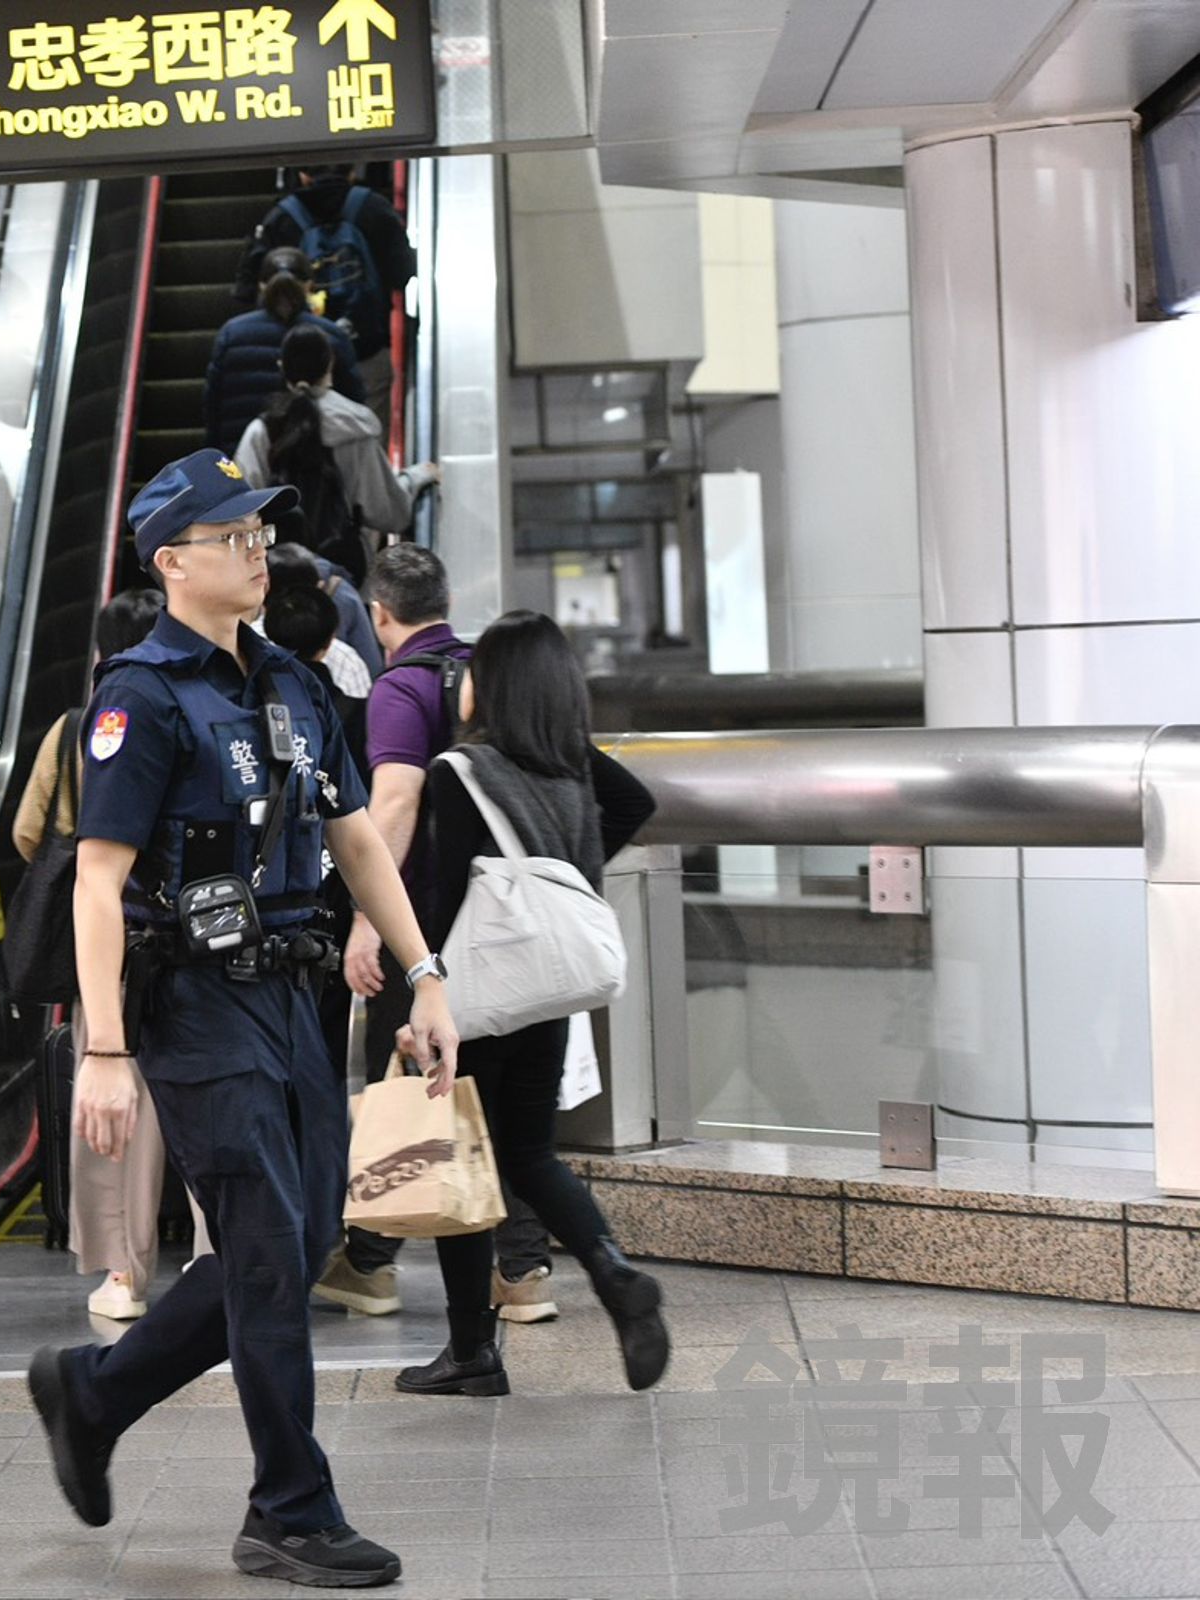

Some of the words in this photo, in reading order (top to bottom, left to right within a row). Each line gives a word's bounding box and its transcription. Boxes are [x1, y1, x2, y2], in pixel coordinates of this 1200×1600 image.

[8, 6, 297, 91] 忠孝西路
[175, 89, 225, 123] W.
[235, 84, 302, 120] Rd.
[327, 63, 395, 132] 出口
[229, 734, 314, 785] 警察
